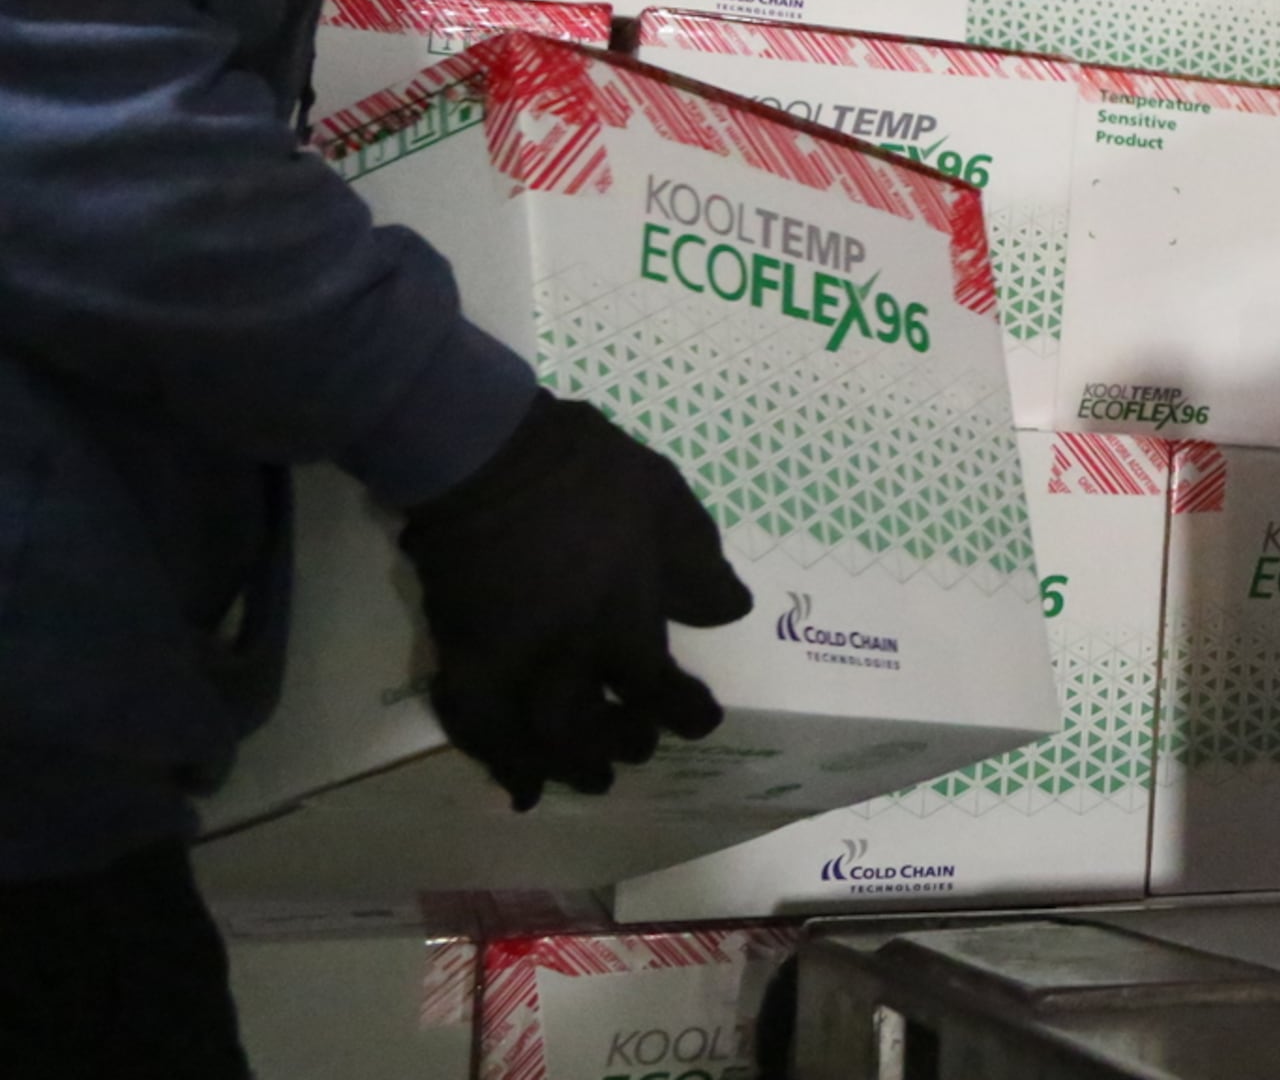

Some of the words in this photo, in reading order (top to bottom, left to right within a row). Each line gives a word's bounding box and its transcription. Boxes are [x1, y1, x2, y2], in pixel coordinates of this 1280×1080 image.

[716, 3, 802, 19] TECHNOLOGIES
[1100, 89, 1211, 114] Temperature
[752, 96, 937, 141] OLTEMP
[1098, 109, 1177, 130] Sensitive
[1096, 130, 1163, 150] Product
[644, 174, 866, 273] KOOLTEMP
[1083, 384, 1182, 402] KOOLTEMP
[803, 625, 846, 649] COLD
[849, 630, 898, 653] CHAIN
[806, 651, 900, 670] TECHNOLOGIES
[849, 865, 896, 880] COLD
[899, 864, 955, 878] CHAIN
[849, 882, 954, 893] TECHNOLOGIES
[606, 1026, 752, 1067] KOOLT
